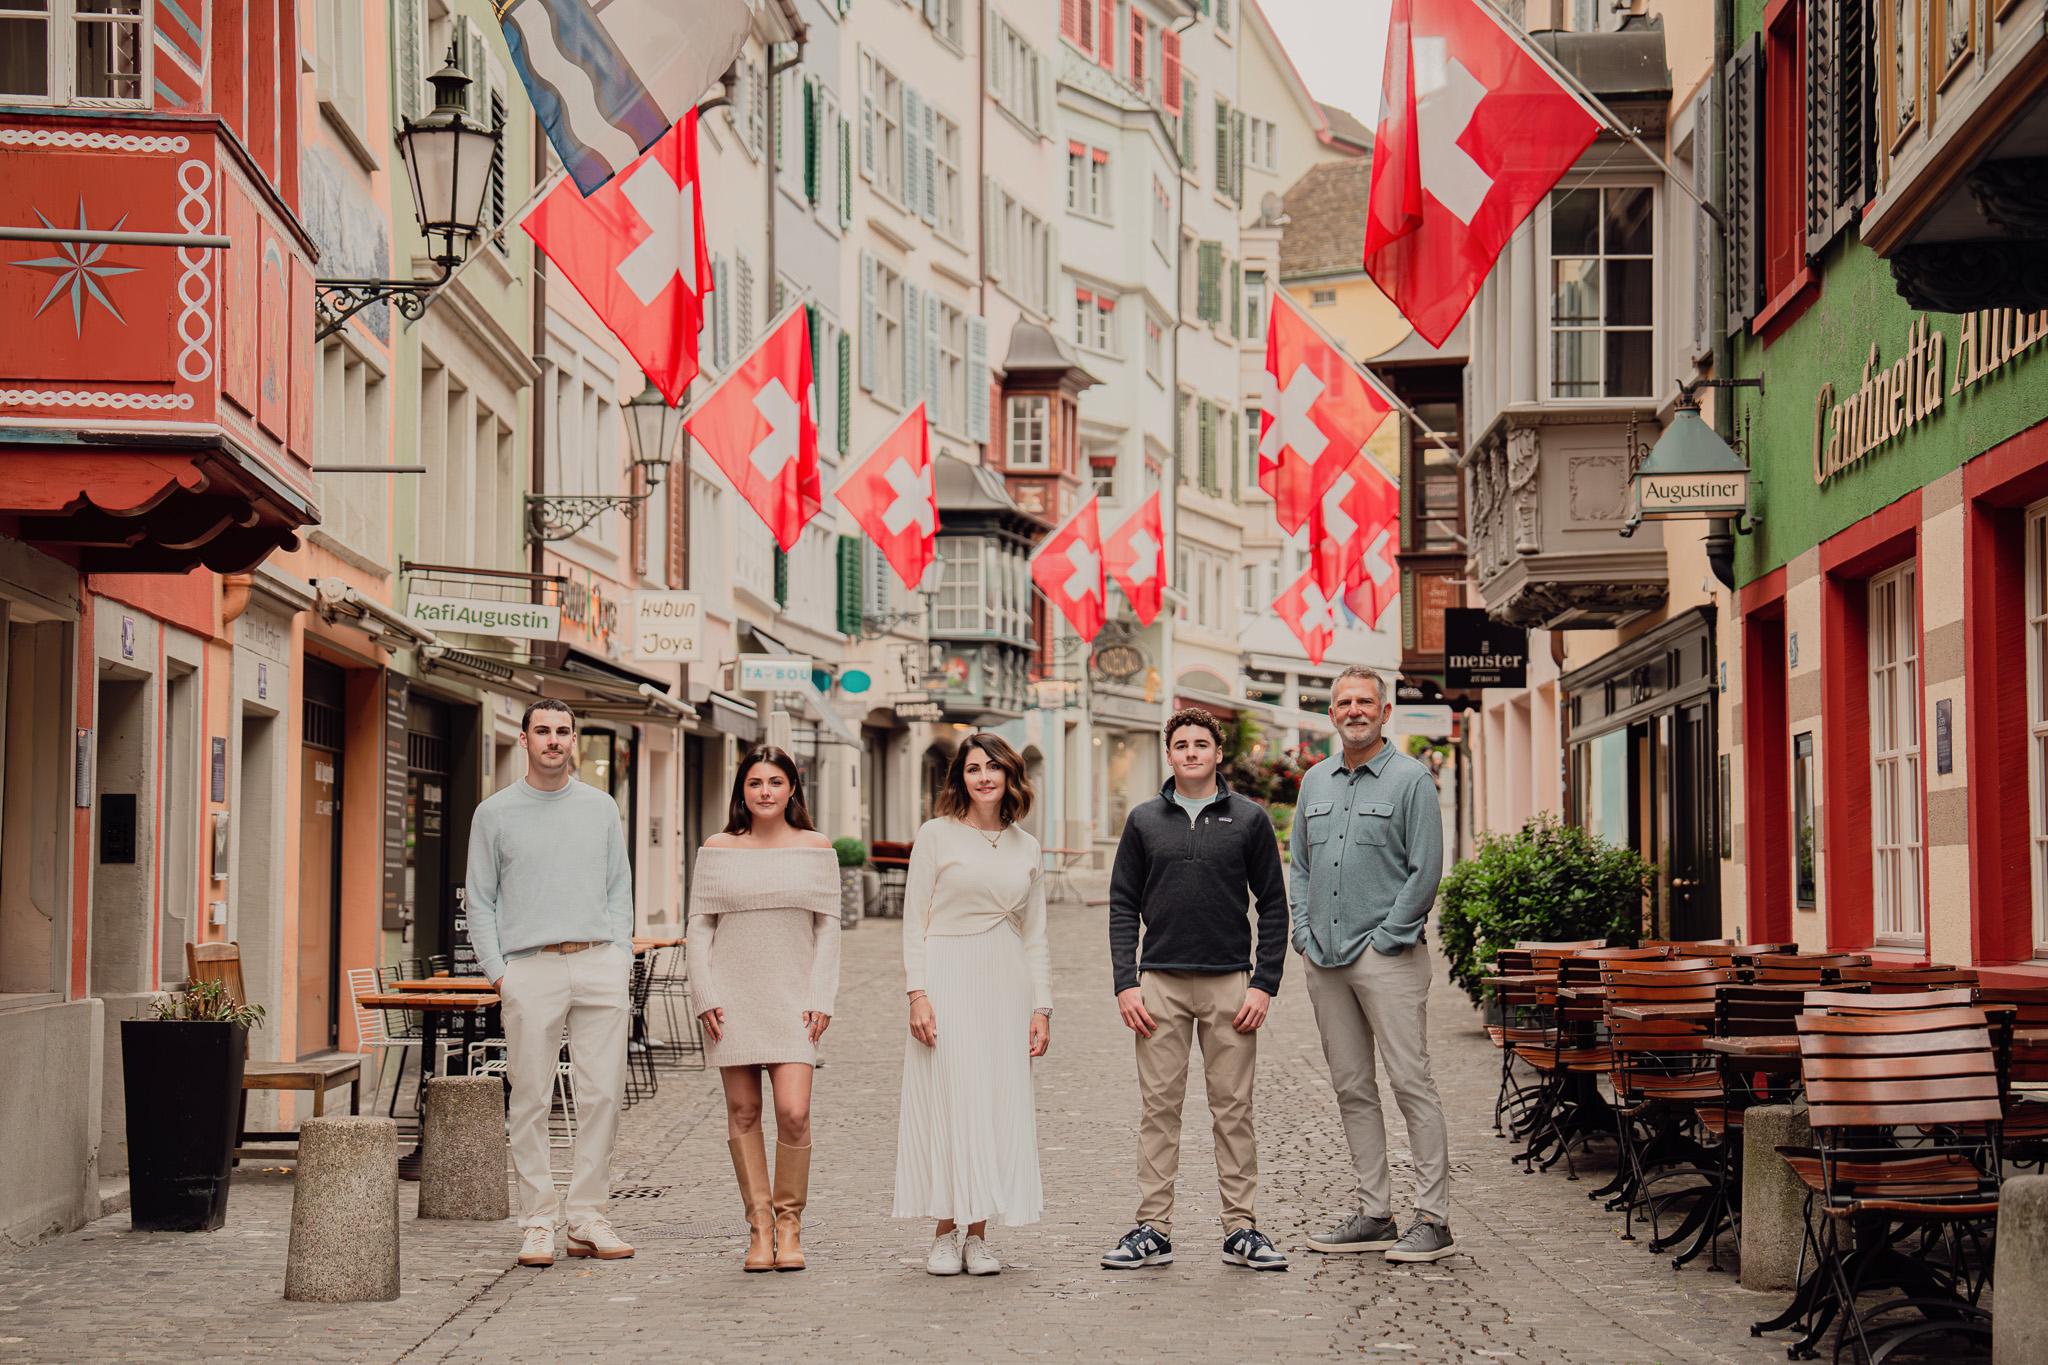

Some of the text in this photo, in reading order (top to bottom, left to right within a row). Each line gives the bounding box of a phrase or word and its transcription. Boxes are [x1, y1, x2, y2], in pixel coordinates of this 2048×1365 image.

[1813, 312, 1944, 485] Cantinetta
[1645, 481, 1739, 504] Augustiner
[642, 633, 693, 655] Joya
[1449, 653, 1522, 668] meister
